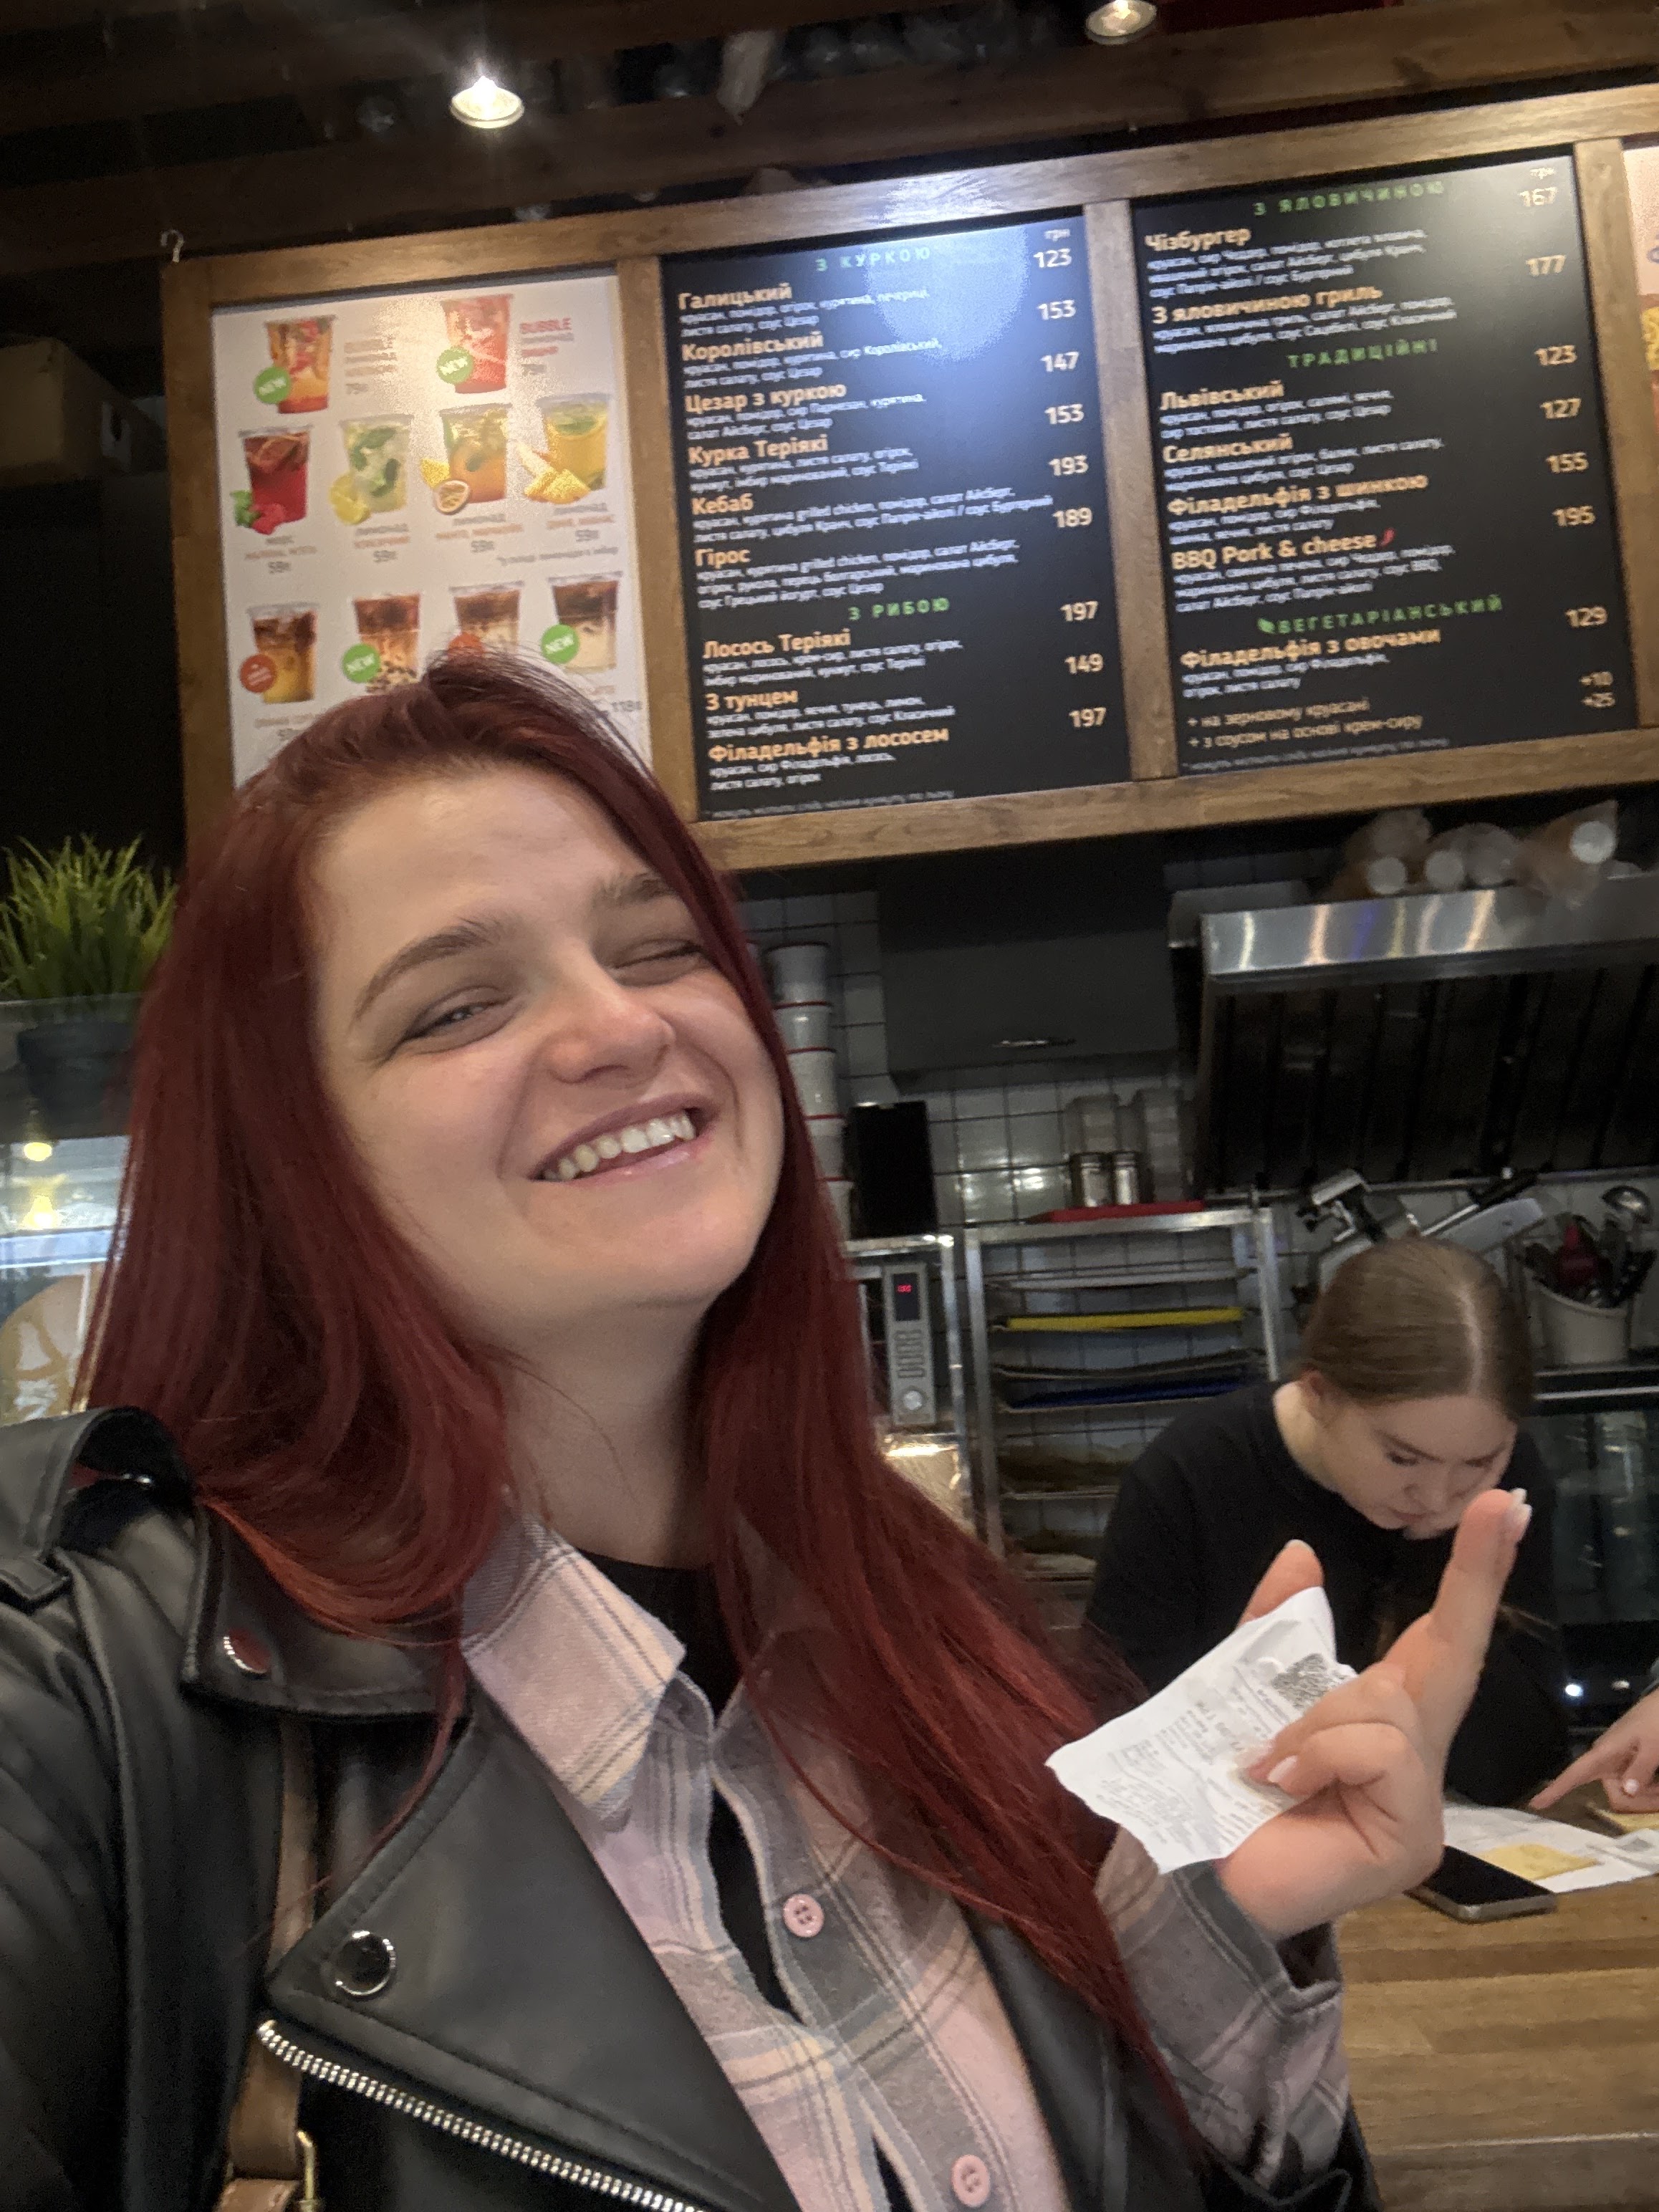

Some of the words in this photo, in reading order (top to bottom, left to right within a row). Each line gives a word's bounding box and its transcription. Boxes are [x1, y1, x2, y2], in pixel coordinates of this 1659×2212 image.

[1278, 181, 1445, 213] ЯЛОВИЧИНОЮ
[1519, 187, 1558, 207] 167
[1144, 228, 1251, 251] Чізбургер
[815, 258, 828, 271] З
[840, 247, 931, 269] КУРКОЮ
[1033, 248, 1072, 268] 123
[1525, 254, 1567, 277] 177
[678, 282, 792, 310] Галицький
[1150, 306, 1168, 324] З
[1171, 294, 1312, 322] яловичиною
[1315, 286, 1383, 309] гриль
[1037, 299, 1076, 320] 153
[681, 330, 824, 362] Королівський
[1287, 338, 1438, 368] ТРАДИЦІЙНІ
[1040, 351, 1079, 372] 147
[685, 394, 749, 415] Цезар
[752, 393, 765, 406] з
[769, 384, 847, 407] куркою
[1160, 379, 1284, 410] Львівський
[1044, 403, 1085, 425] 153
[1539, 398, 1582, 419] 127
[688, 445, 751, 467] Курка
[753, 433, 829, 459] Теріякі
[1162, 432, 1294, 463] Селянський
[1049, 454, 1089, 476] 193
[1546, 451, 1589, 473] 155
[691, 493, 754, 515] Кебаб
[1167, 485, 1312, 515] Філадельфія
[1317, 486, 1331, 500] з
[1335, 474, 1429, 497] шинкою
[1052, 507, 1093, 528] 189
[1171, 549, 1217, 570] BBQ
[1222, 542, 1274, 564] Pork
[1277, 539, 1297, 558] &
[1302, 534, 1377, 556] cheese
[848, 607, 861, 621] З
[871, 597, 950, 618] РИБОЮ
[1060, 600, 1099, 622] 197
[1277, 594, 1503, 635] ВЕГЕТАРІАНСЬКИЙ
[1564, 605, 1608, 628] 129
[703, 640, 776, 659] Лосось
[778, 627, 851, 653] Теріякі
[1180, 639, 1322, 668] Філадельфія
[1327, 640, 1340, 654] з
[1345, 628, 1441, 652] овочами
[1064, 653, 1104, 675] 149
[705, 693, 720, 711] З
[723, 690, 799, 713] тунцем
[1069, 707, 1107, 728] 197
[708, 736, 841, 762] Філадельфія
[846, 737, 859, 751] з
[862, 728, 950, 749] лососем
